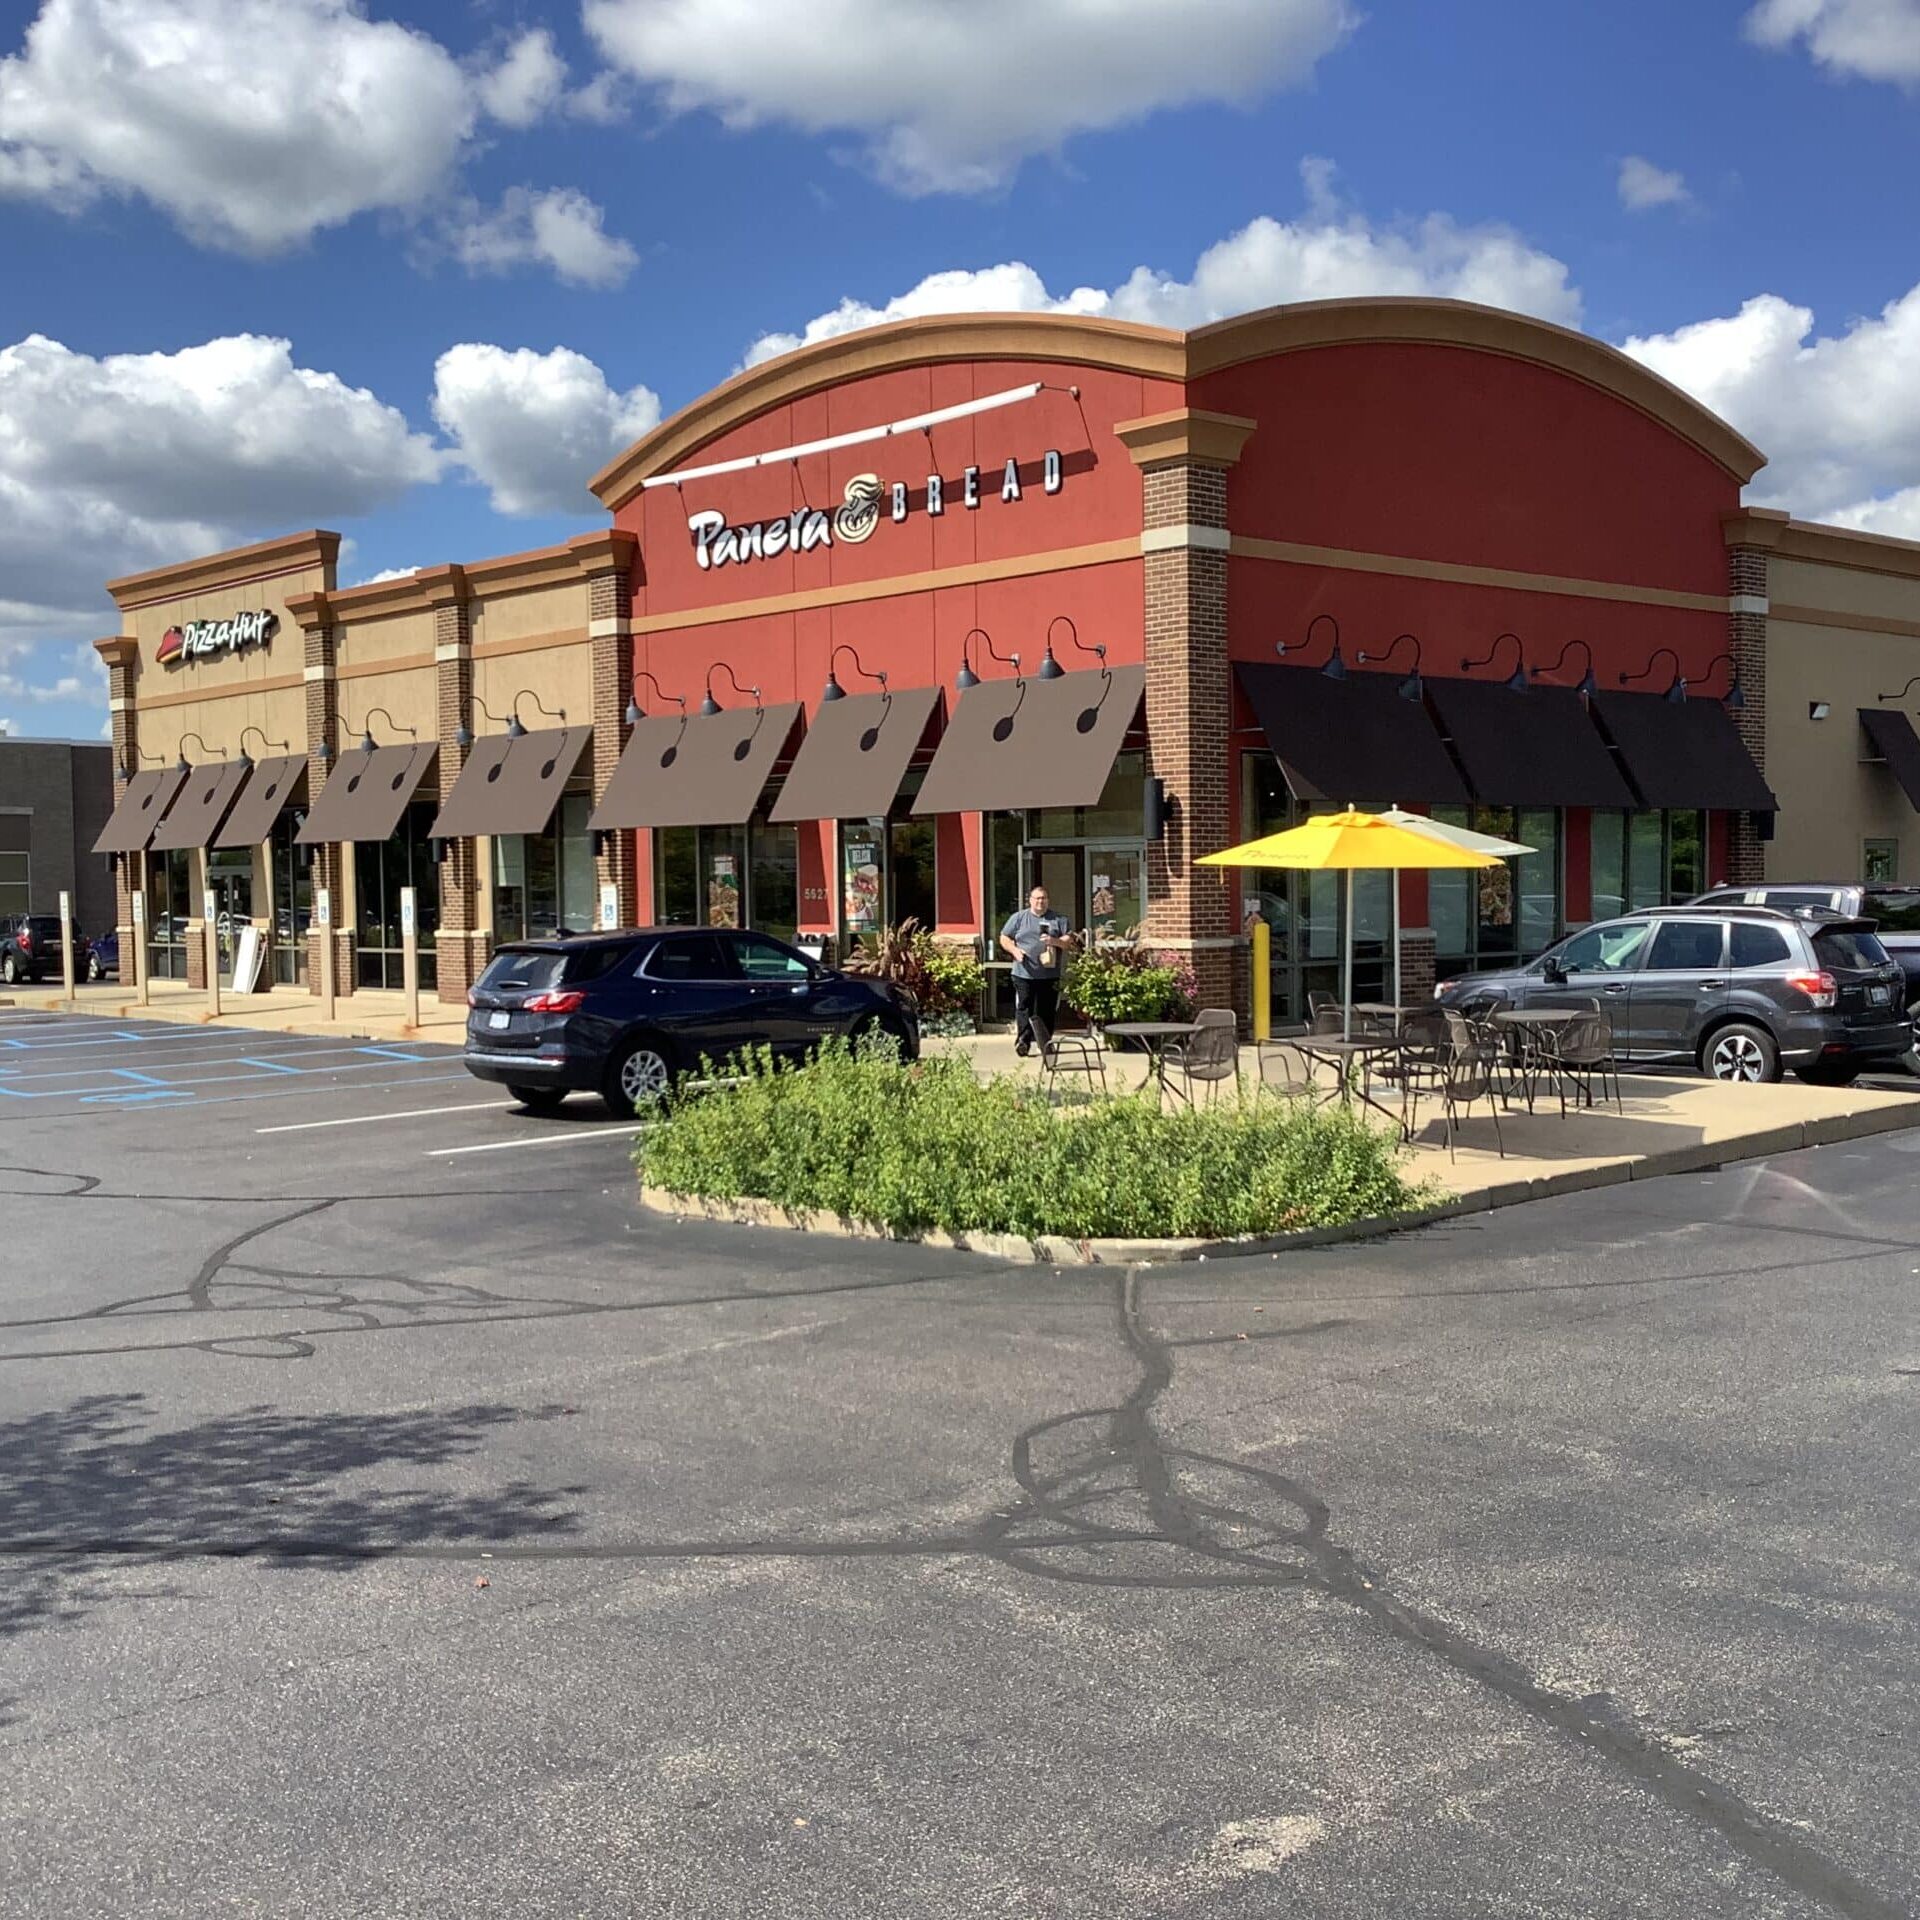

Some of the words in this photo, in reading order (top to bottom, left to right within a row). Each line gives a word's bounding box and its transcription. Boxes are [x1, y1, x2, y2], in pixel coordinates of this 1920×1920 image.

[688, 507, 834, 569] Panera
[892, 450, 1061, 522] BREAD
[181, 619, 231, 660] Pizza
[229, 610, 271, 651] Hut
